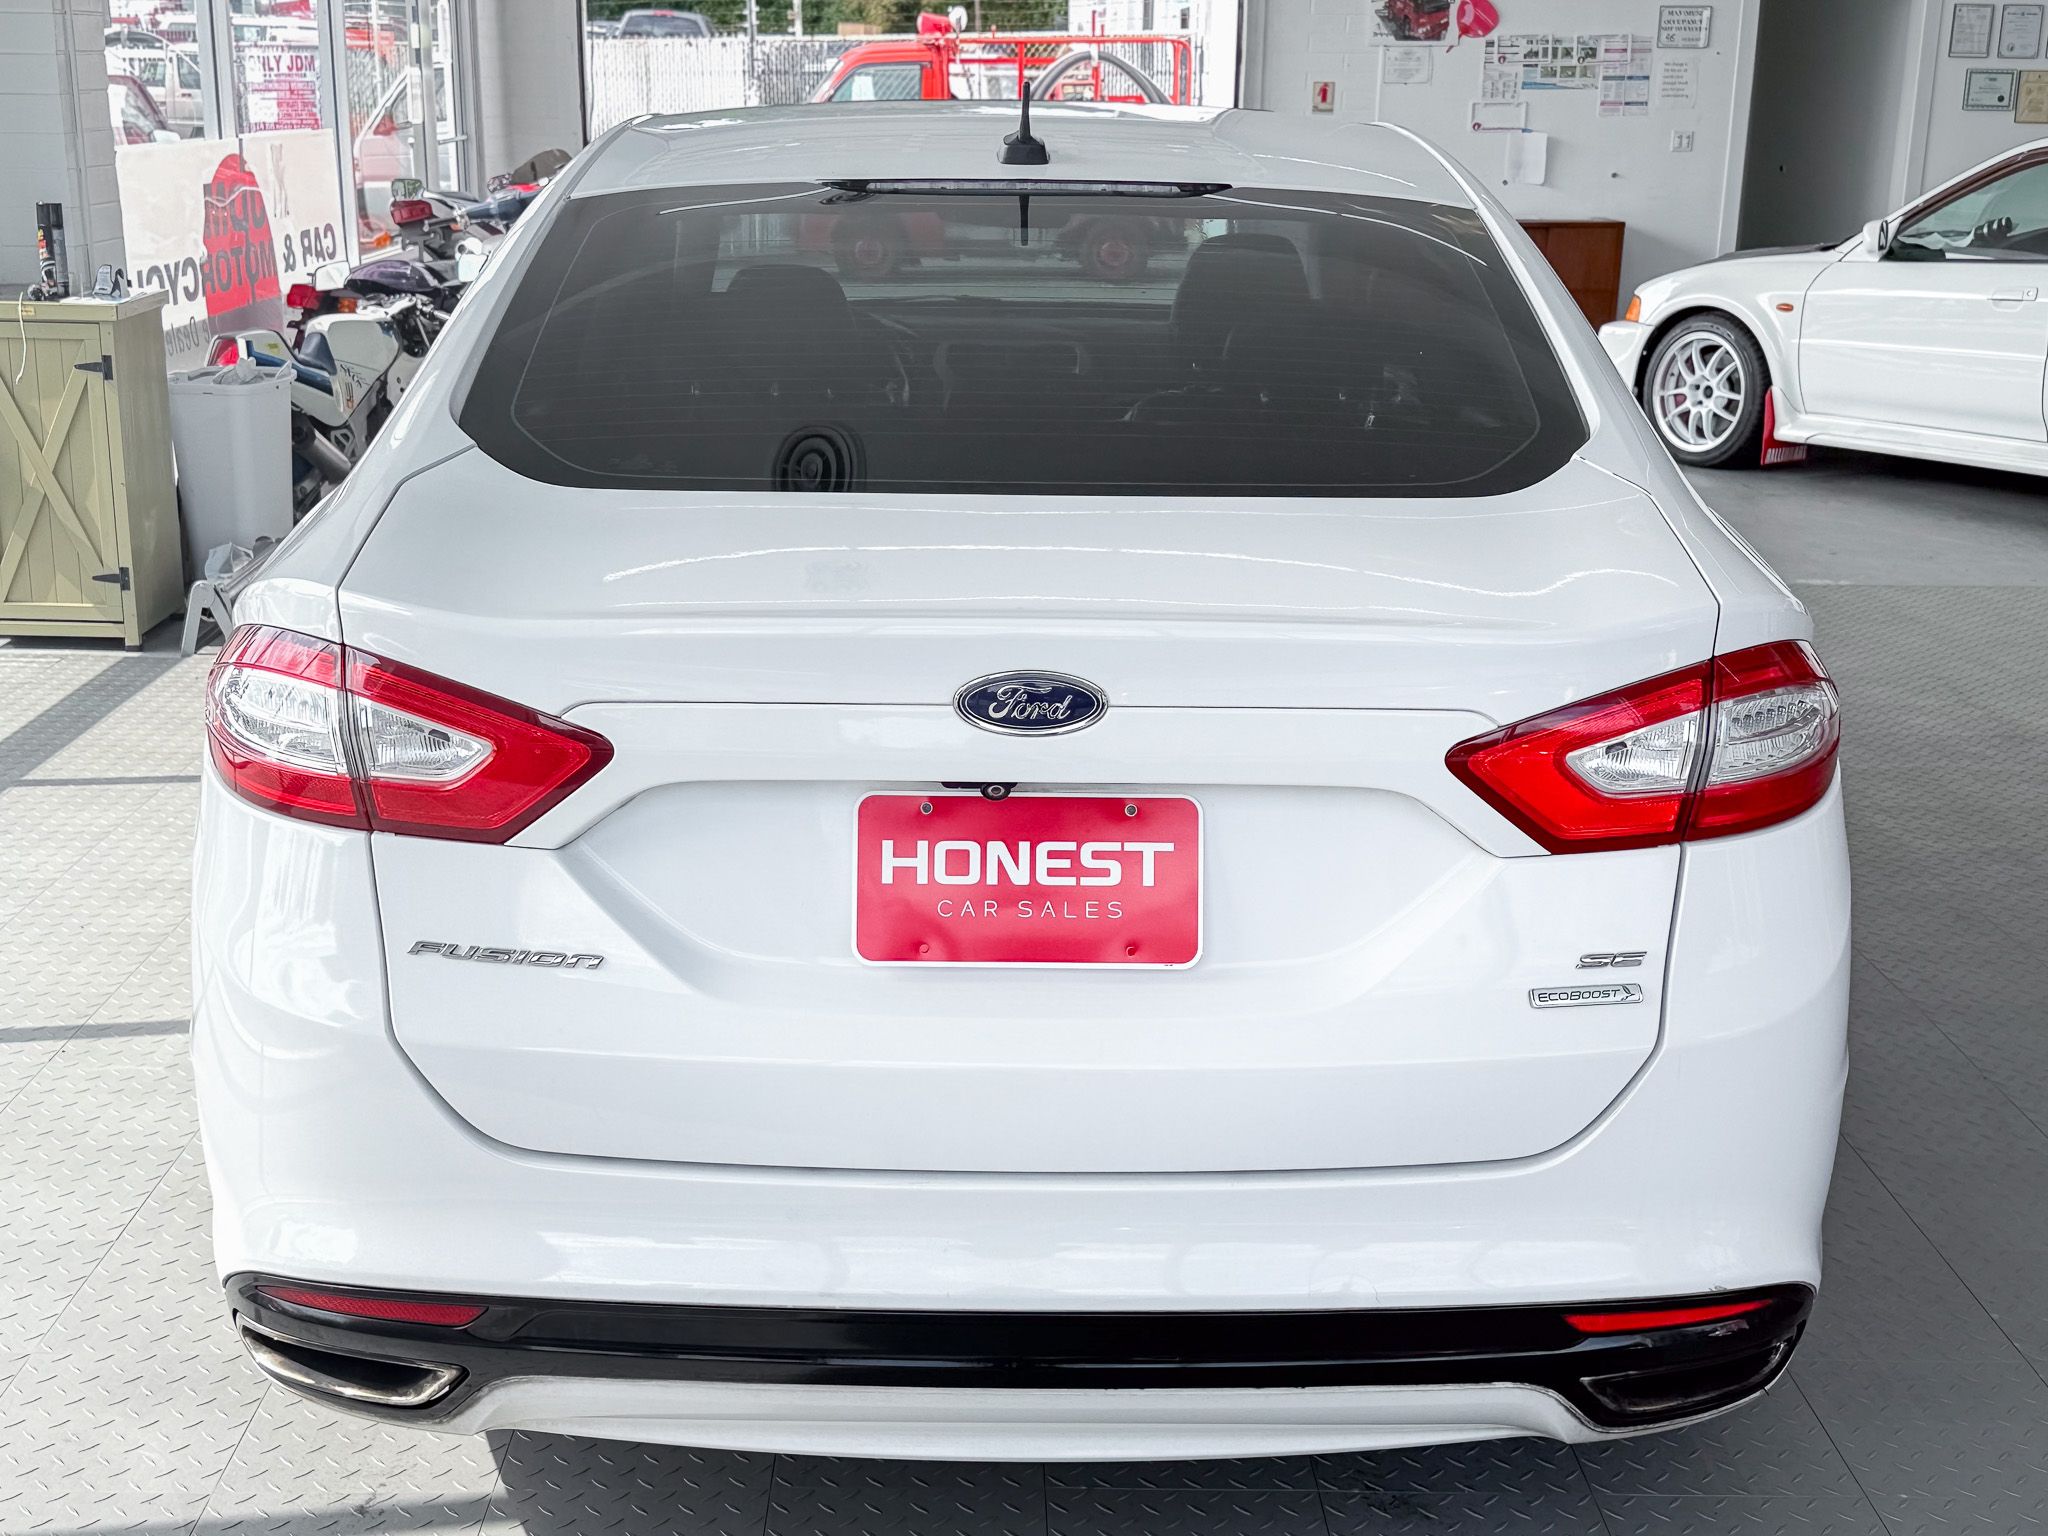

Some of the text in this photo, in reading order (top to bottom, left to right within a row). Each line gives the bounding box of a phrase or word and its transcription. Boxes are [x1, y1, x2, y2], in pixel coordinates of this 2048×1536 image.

[287, 55, 316, 72] JDM
[988, 685, 1073, 720] Ford
[881, 840, 1175, 887] HONEST
[937, 900, 1124, 919] CAR SALES
[407, 940, 605, 970] FUSION
[1575, 951, 1648, 969] SE
[1537, 988, 1621, 1003] ECOBOOST
